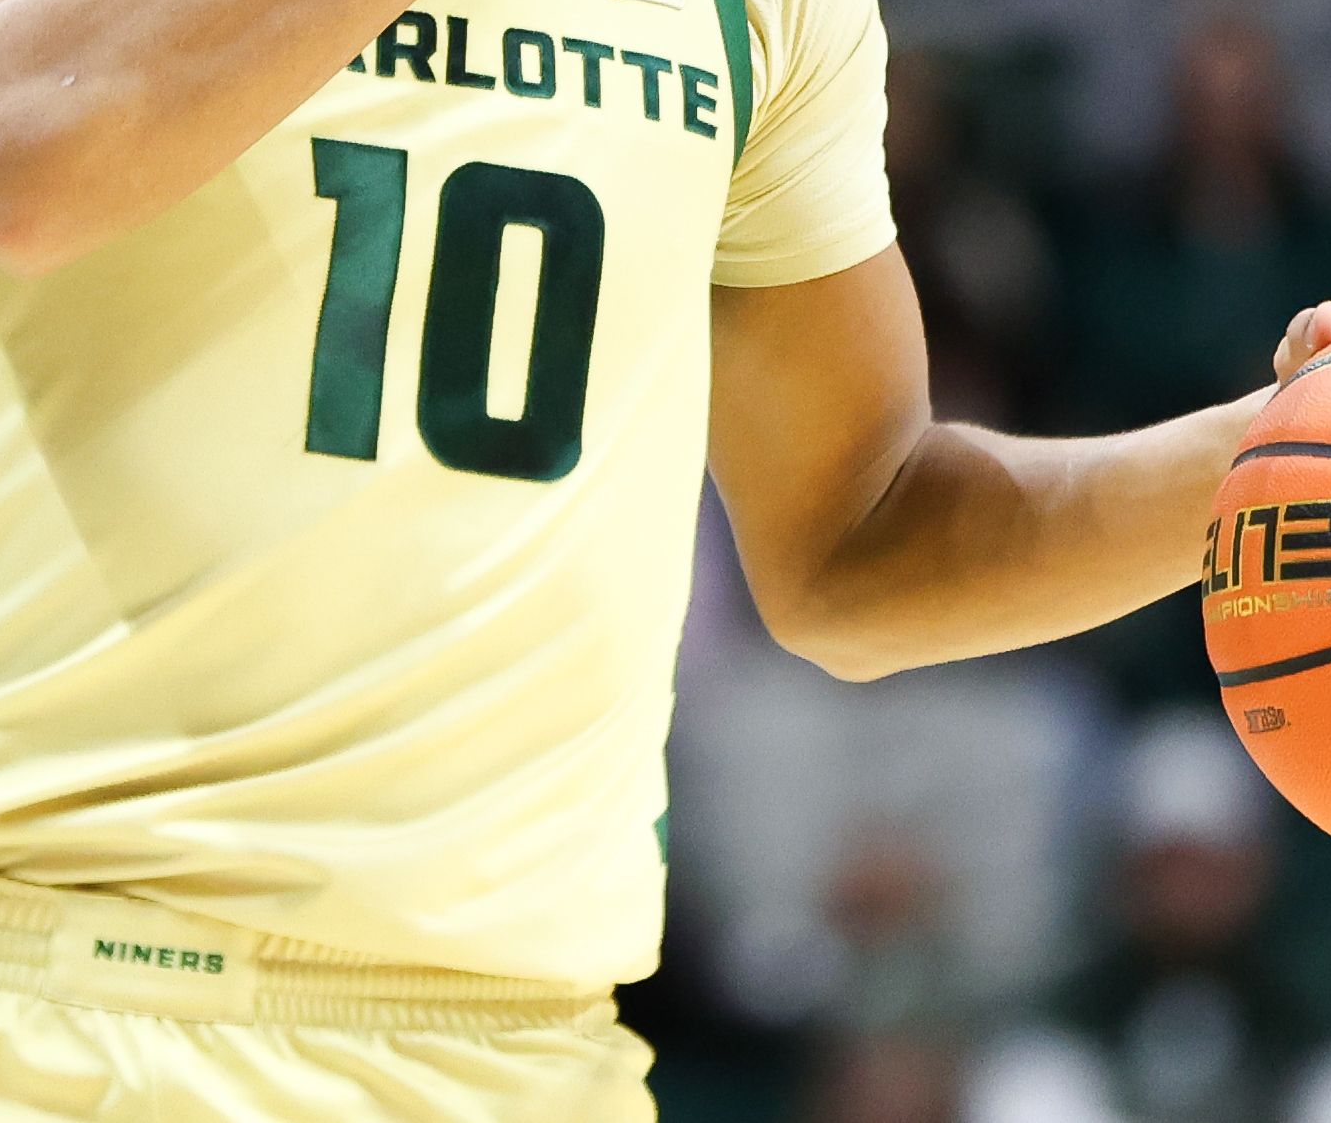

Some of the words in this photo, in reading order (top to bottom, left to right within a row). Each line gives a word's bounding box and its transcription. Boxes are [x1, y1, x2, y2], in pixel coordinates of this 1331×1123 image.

[346, 10, 719, 140] RLOTTE
[304, 136, 606, 484] 10
[94, 938, 225, 975] NINERS
